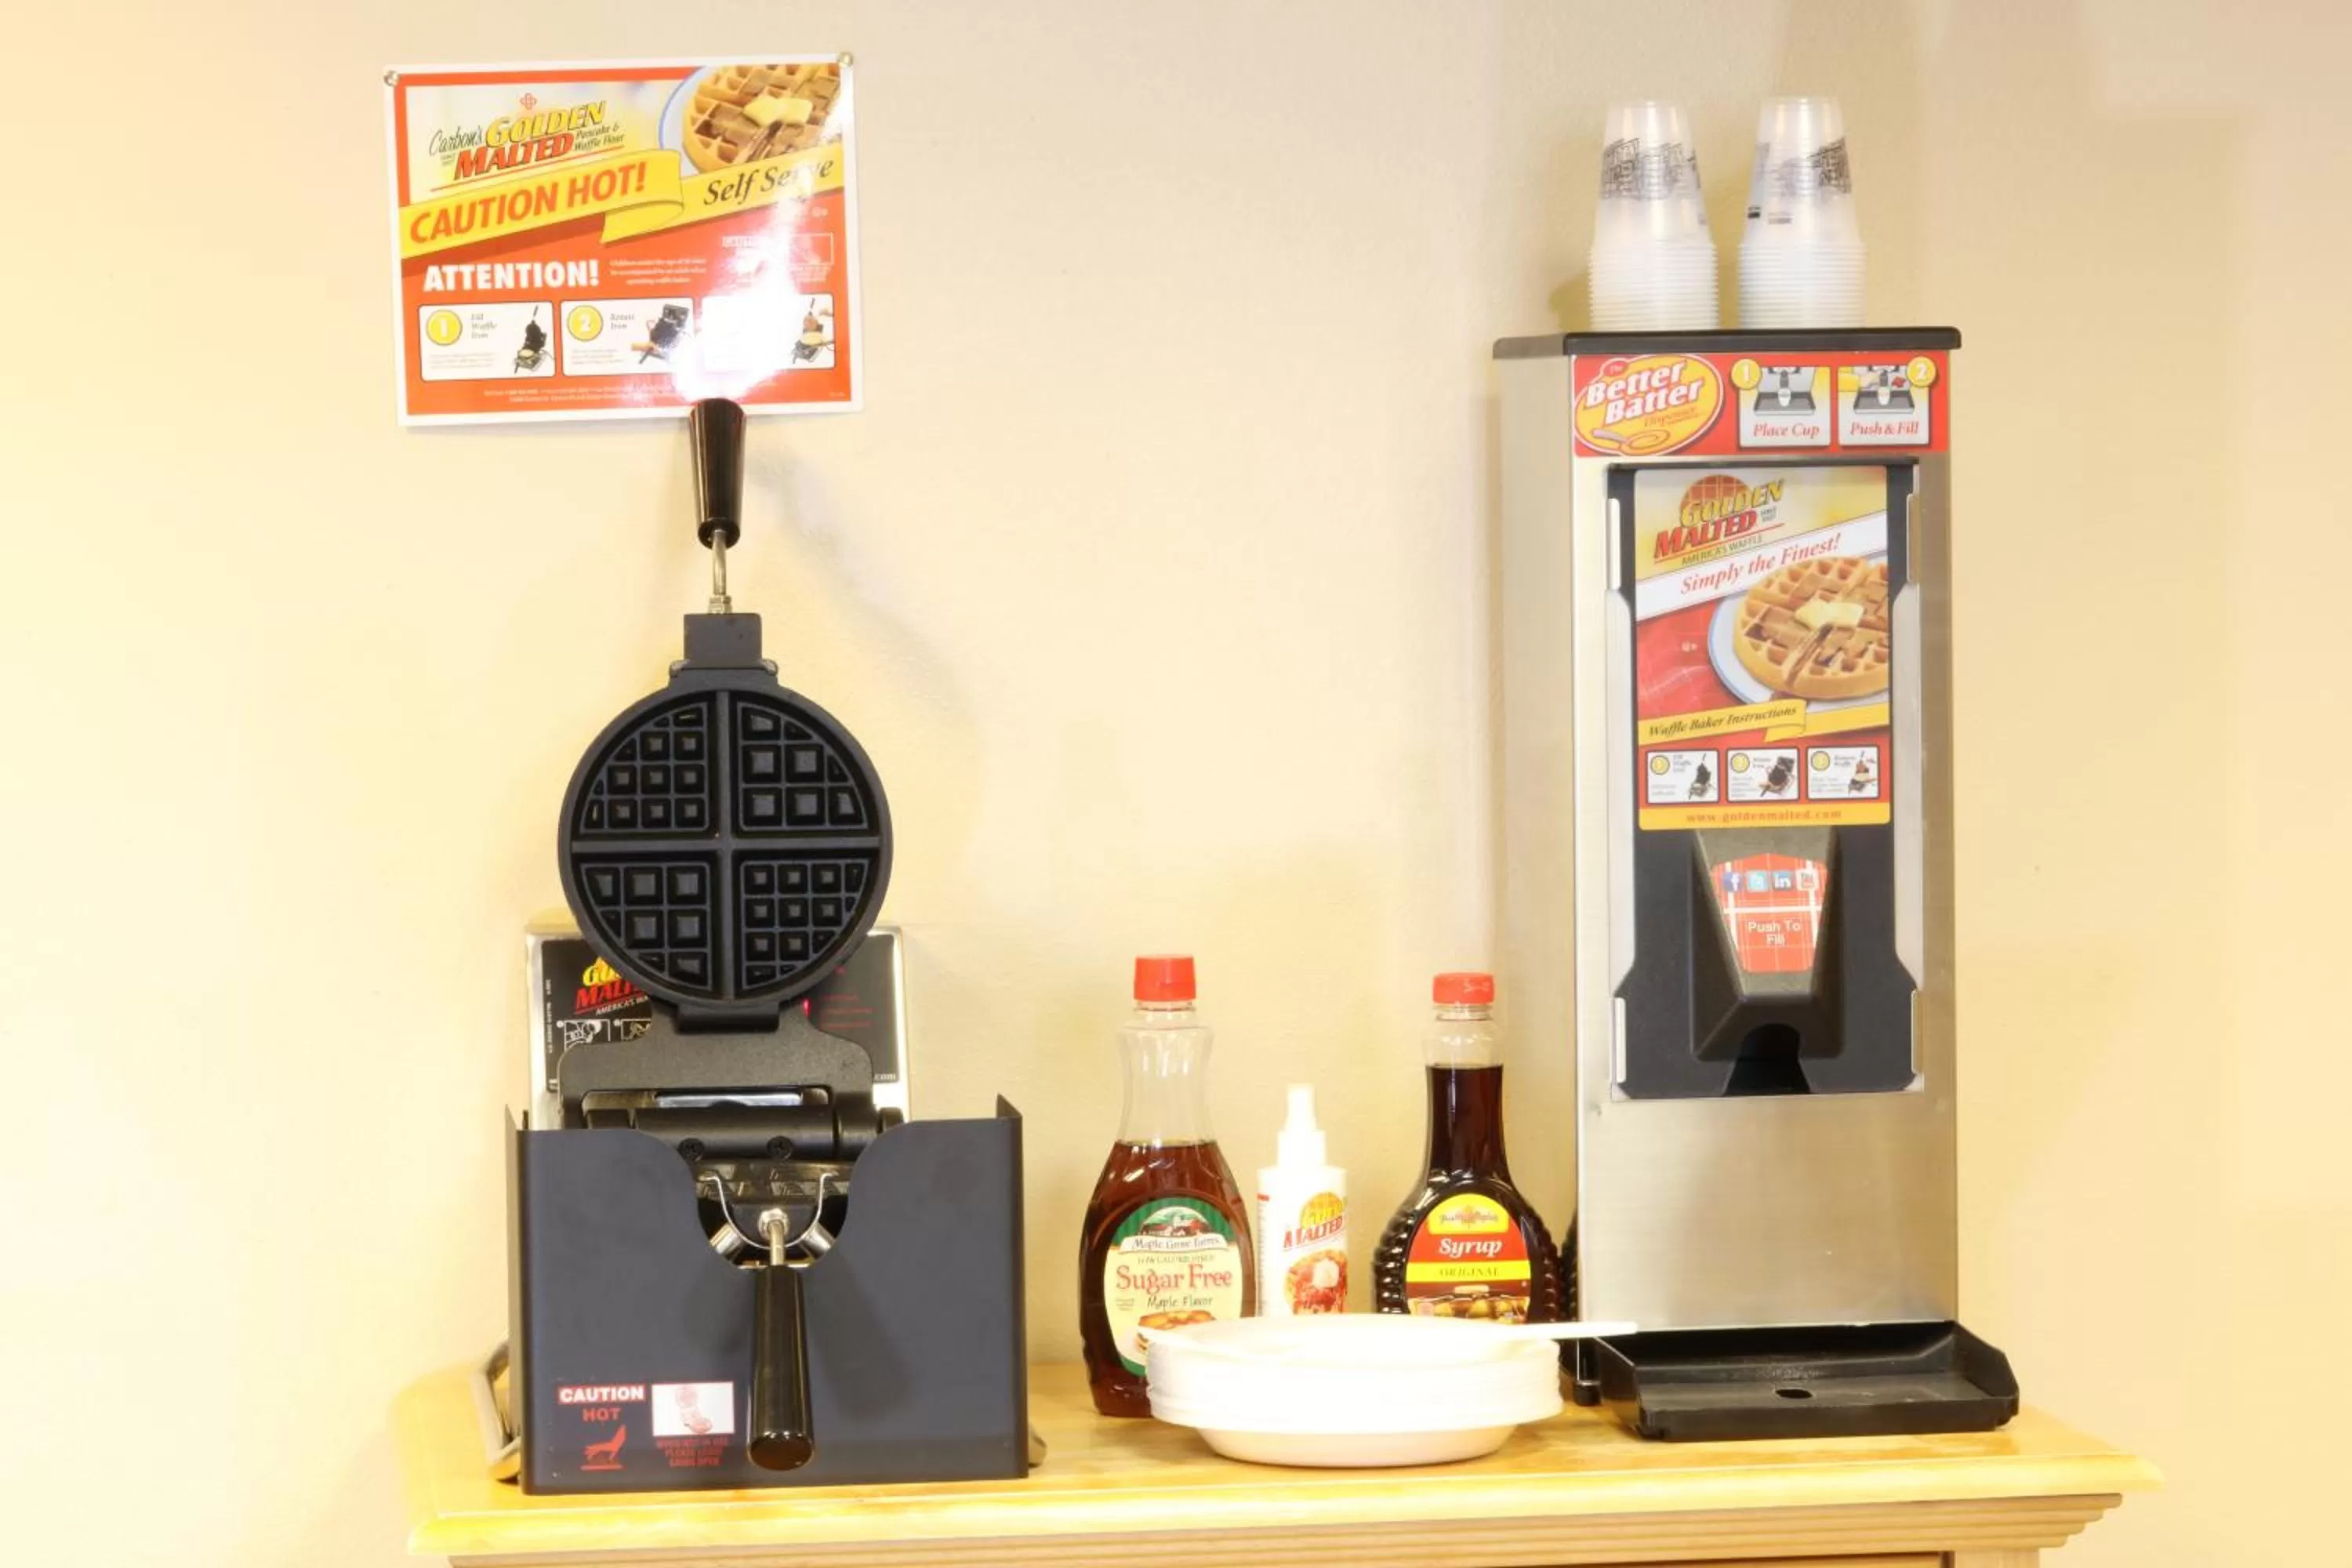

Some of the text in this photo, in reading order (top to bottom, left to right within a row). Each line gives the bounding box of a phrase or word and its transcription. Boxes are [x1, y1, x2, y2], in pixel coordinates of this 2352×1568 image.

[486, 100, 606, 147] GOLDEN
[453, 132, 575, 180] MALTED
[703, 160, 834, 205] Self See
[410, 161, 648, 244] CAUTION HOT!
[423, 260, 600, 292] ATTENTION!
[1585, 361, 1686, 409] Better
[1741, 364, 1751, 383] 1
[1916, 361, 1927, 381] 2
[1604, 378, 1704, 425] Batter
[1753, 423, 1820, 439] Place Cup
[1850, 421, 1919, 436] Push & Fill
[1680, 477, 1785, 528] GOLDEN
[1654, 510, 1758, 558] MALTED
[1680, 532, 1842, 594] Simply the Finest!
[1649, 706, 1798, 739] Waffle Baker Instructions
[1748, 919, 1802, 933] Push To
[1766, 934, 1786, 947] Fill
[1283, 1214, 1344, 1249] MALTED
[1439, 1237, 1503, 1259] Syrup
[1116, 1263, 1233, 1294] Sugar Free
[1439, 1267, 1500, 1278] ORIGINAL
[1147, 1294, 1178, 1311] Maple
[1182, 1294, 1214, 1306] Flavor
[559, 1385, 644, 1403] CAUTION
[583, 1407, 621, 1421] HOT
